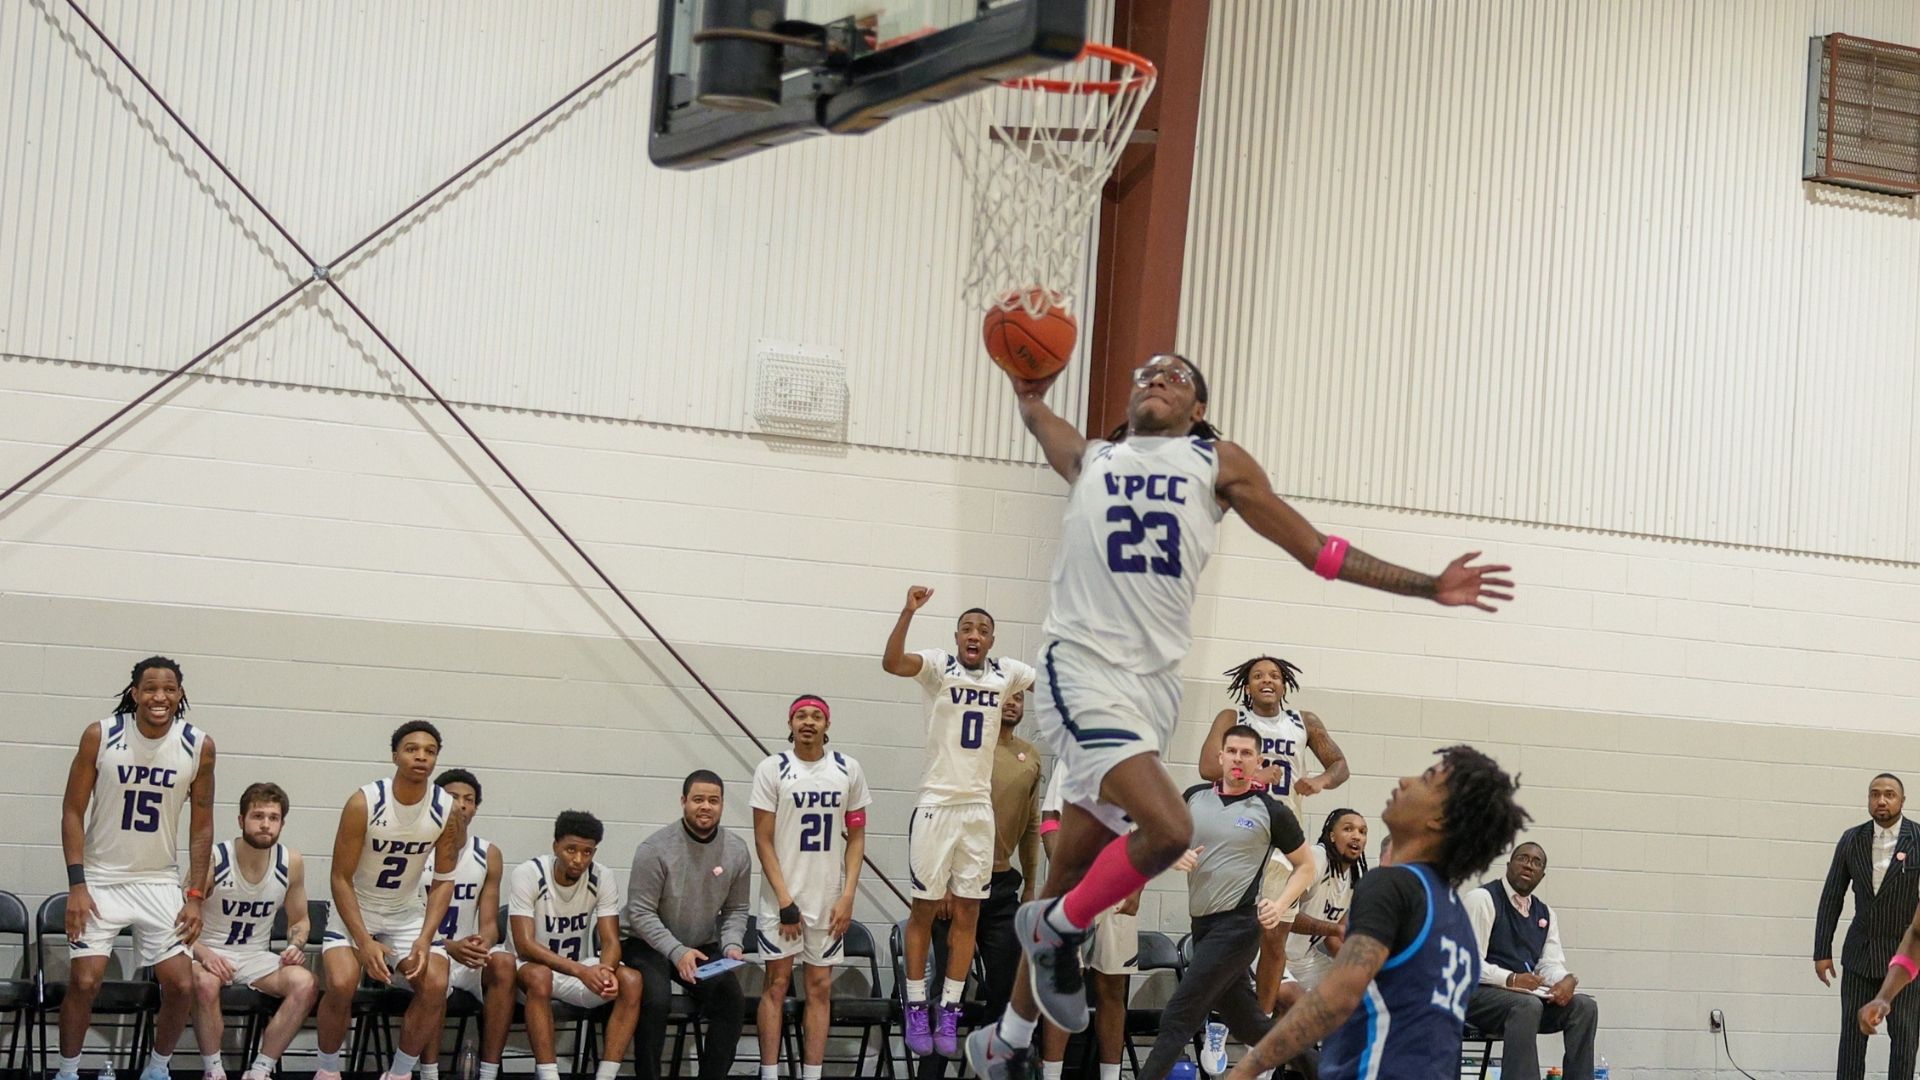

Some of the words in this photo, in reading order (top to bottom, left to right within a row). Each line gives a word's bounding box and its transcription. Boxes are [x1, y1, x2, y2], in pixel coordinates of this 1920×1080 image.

[1104, 472, 1188, 506] VPCC
[1106, 504, 1182, 579] 23
[949, 686, 1000, 708] VPCC
[960, 710, 985, 750] 0
[1262, 737, 1296, 757] PCC
[117, 764, 178, 789] VPCC
[120, 789, 164, 833] 15
[792, 790, 842, 809] VPCC
[799, 813, 834, 852] 21
[371, 837, 433, 856] VPCC
[375, 855, 409, 890] 2
[424, 883, 478, 900] CC
[221, 898, 275, 918] VPCC
[223, 920, 256, 945] 11
[437, 905, 460, 941] 4
[544, 912, 588, 933] VPCC
[1431, 935, 1472, 1021] 32
